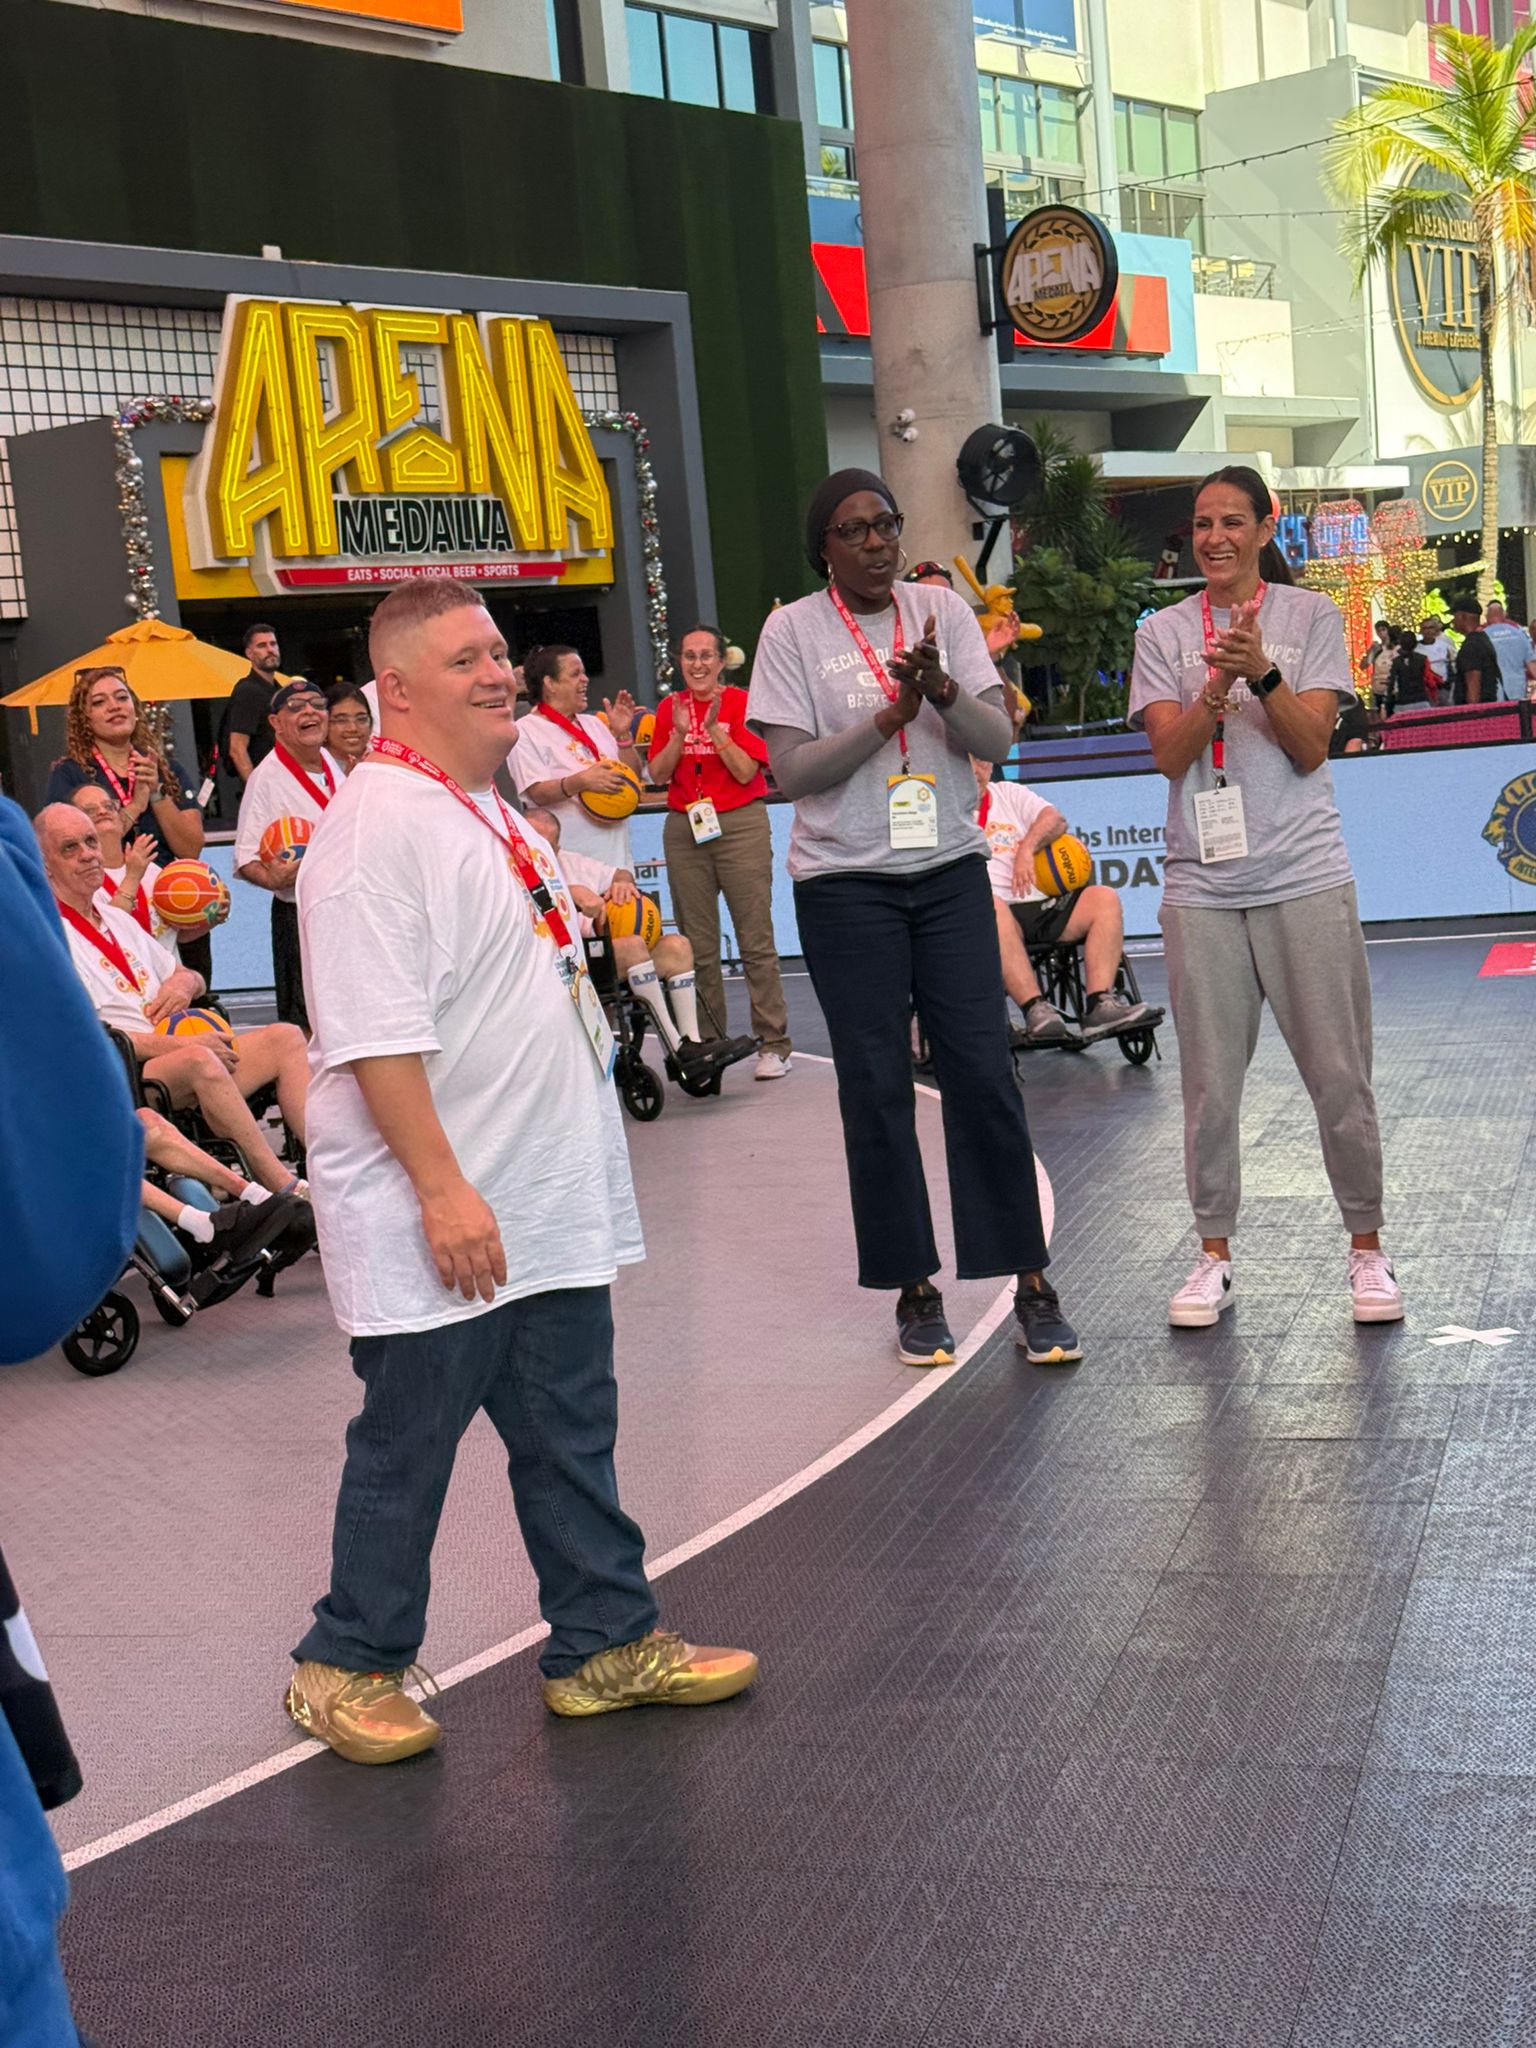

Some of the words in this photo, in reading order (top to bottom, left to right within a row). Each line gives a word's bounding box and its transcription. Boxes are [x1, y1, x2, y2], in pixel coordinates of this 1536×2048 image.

[1007, 241, 1102, 307] ARENA
[1406, 240, 1480, 328] VIP
[206, 299, 614, 558] ARENA
[1429, 479, 1471, 505] VIP
[336, 498, 516, 556] MEDALLA
[347, 568, 373, 582] EATS
[379, 567, 416, 580] SOCIAL
[421, 566, 451, 579] LOCAL
[453, 565, 478, 577] BEER
[483, 564, 520, 577] SPORTS
[1058, 846, 1077, 885] molten
